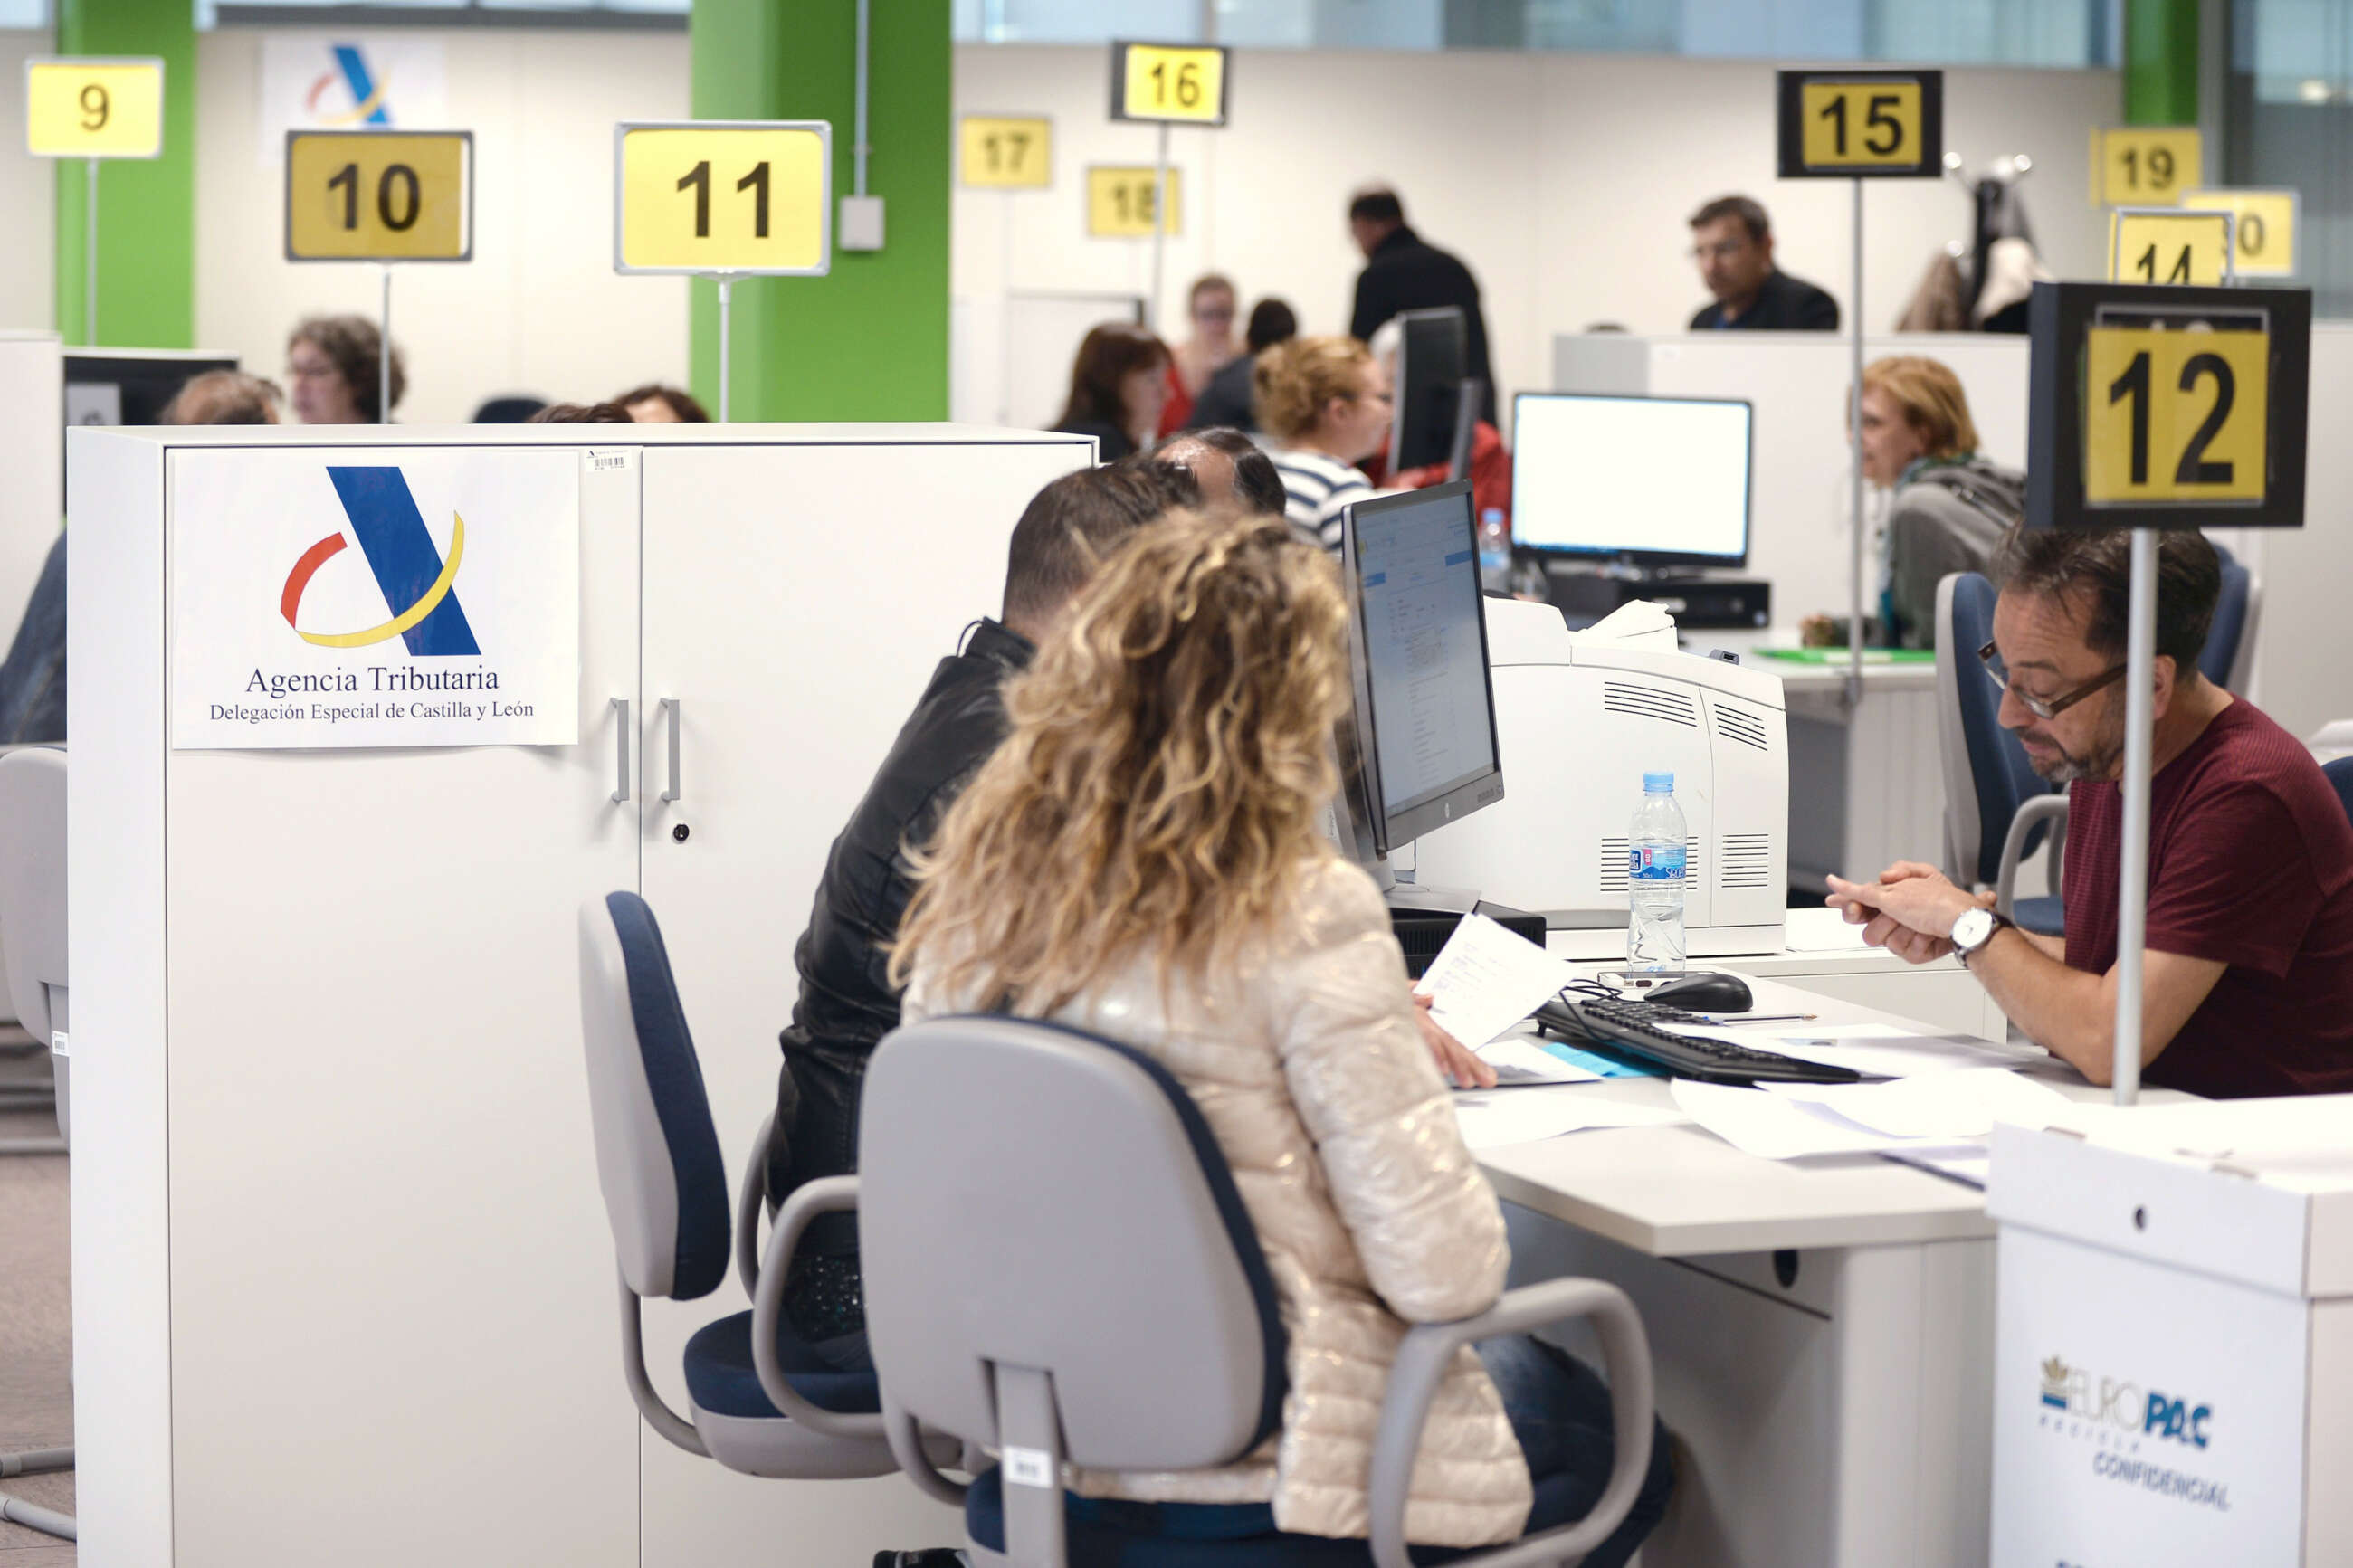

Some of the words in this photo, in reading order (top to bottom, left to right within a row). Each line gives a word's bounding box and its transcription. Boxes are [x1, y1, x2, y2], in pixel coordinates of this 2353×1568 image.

[80, 83, 110, 132] 9
[1150, 62, 1201, 109] 16
[1820, 93, 1905, 157] 15
[983, 131, 1031, 173] 17
[2118, 145, 2177, 190] 19
[327, 162, 422, 233] 10
[676, 159, 771, 239] 11
[2222, 212, 2266, 258] 0
[2108, 348, 2236, 487] 12
[245, 666, 358, 699] Agencia
[367, 664, 500, 691] Tributaria
[210, 703, 305, 725] Delegación
[311, 702, 380, 724] Especial
[386, 702, 405, 718] de
[410, 701, 472, 718] Castilla
[477, 705, 487, 721] y
[491, 700, 534, 717] León
[2092, 1450, 2233, 1512] CONFIDENCIAL
